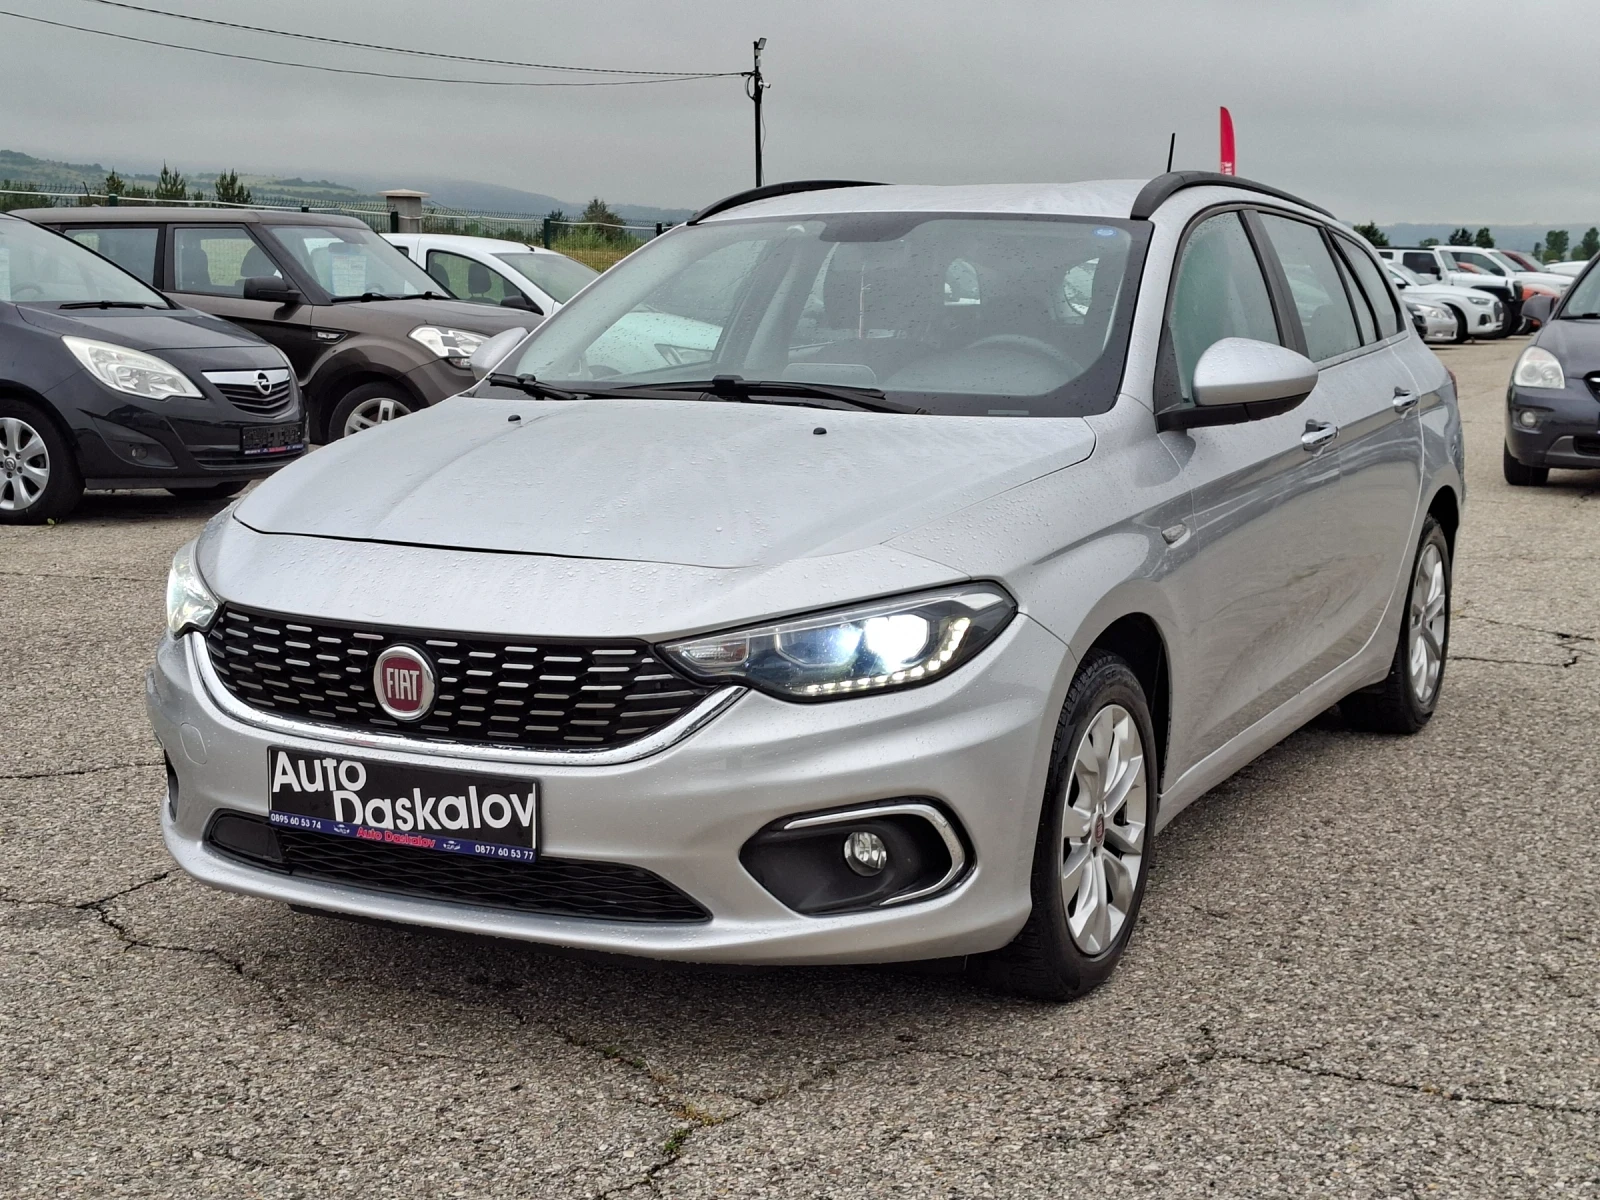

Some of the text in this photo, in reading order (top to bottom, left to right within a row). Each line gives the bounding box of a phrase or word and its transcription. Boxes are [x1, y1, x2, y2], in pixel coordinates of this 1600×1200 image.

[386, 668, 420, 701] FIAT
[272, 751, 367, 793] Auto
[270, 813, 322, 829] 0895 60 53 74
[333, 785, 534, 831] Daskalov
[356, 826, 436, 848] Auto Daskalov
[475, 844, 534, 860] 0877 60 53 77
